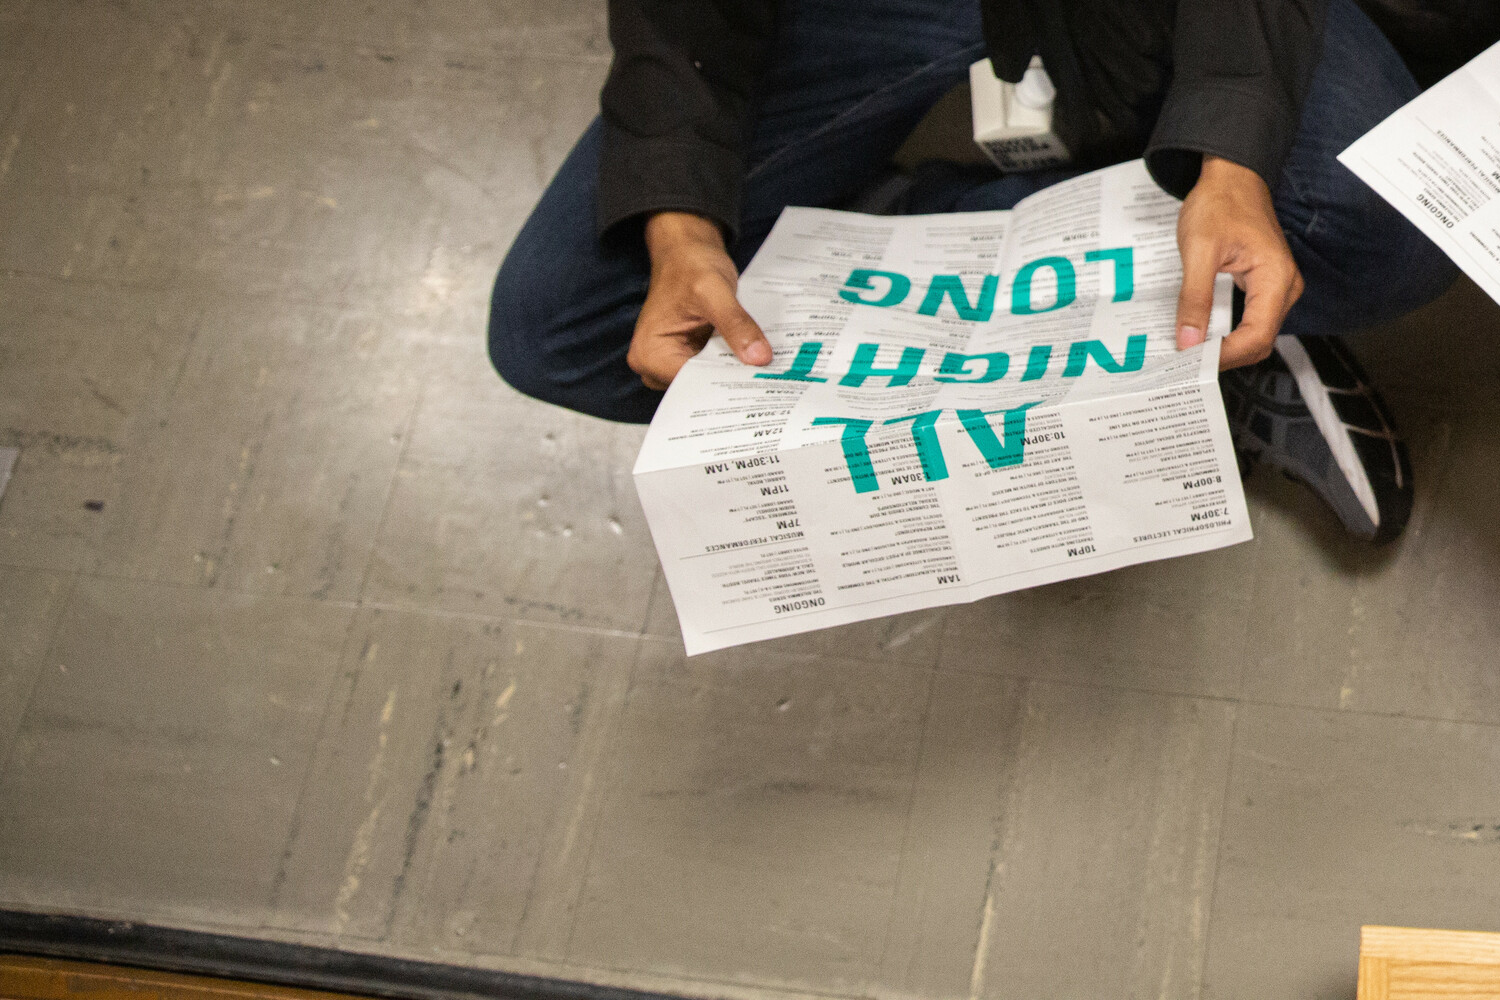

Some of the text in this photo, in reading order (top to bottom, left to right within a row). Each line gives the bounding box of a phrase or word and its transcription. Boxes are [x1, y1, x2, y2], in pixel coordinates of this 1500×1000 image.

[1434, 128, 1479, 170] PERFORMANCES
[1415, 192, 1455, 229] ONGOING
[839, 247, 1134, 321] LONG
[754, 334, 1147, 387] NIGHT
[753, 427, 783, 437] 12AM
[1019, 430, 1065, 446] 10:30PM
[811, 402, 1046, 493] ALL
[704, 453, 779, 474] 11:30PM, 1AM
[890, 470, 930, 485] 1:30AM
[1182, 475, 1221, 489] 8:00PM
[760, 483, 789, 496] 11PM
[1190, 506, 1228, 521] 7:30PM
[776, 518, 799, 529] 7PM
[1132, 519, 1231, 542] PHILOSOPHICAL LECTURES
[705, 530, 803, 552] MUSICAL PERFORMANCES
[1066, 544, 1095, 556] 10PM
[936, 573, 960, 584] 1AM
[773, 597, 825, 613] ONGOING
